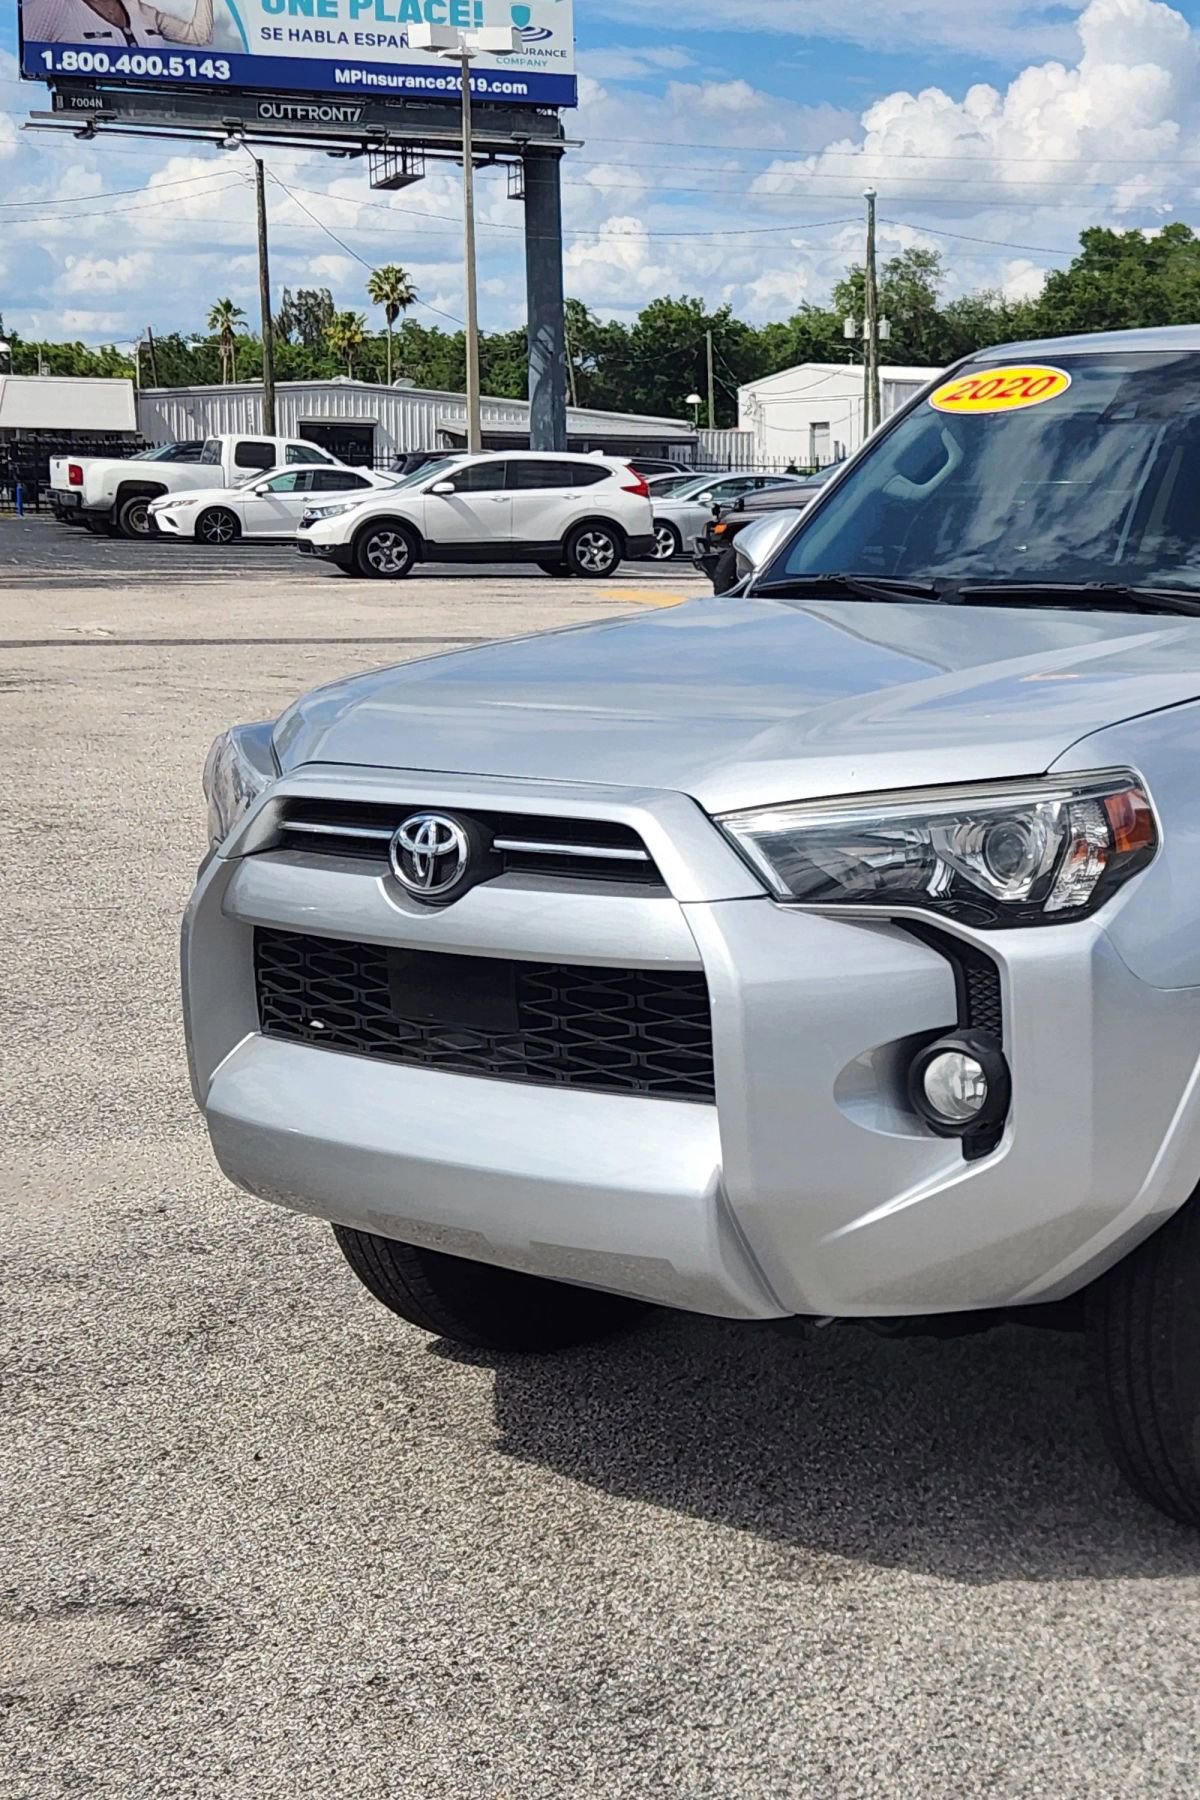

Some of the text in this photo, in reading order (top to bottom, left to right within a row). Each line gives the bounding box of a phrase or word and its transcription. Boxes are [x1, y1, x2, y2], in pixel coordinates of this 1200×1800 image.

[262, 0, 483, 28] ONE PLACE!
[260, 27, 410, 49] SE HABLA ESPAÑ
[496, 57, 548, 67] COMPANY
[522, 47, 567, 58] URANCE
[41, 50, 231, 80] 1.800.400.5143
[70, 96, 103, 108] 7004N
[939, 376, 1057, 402] 2020
